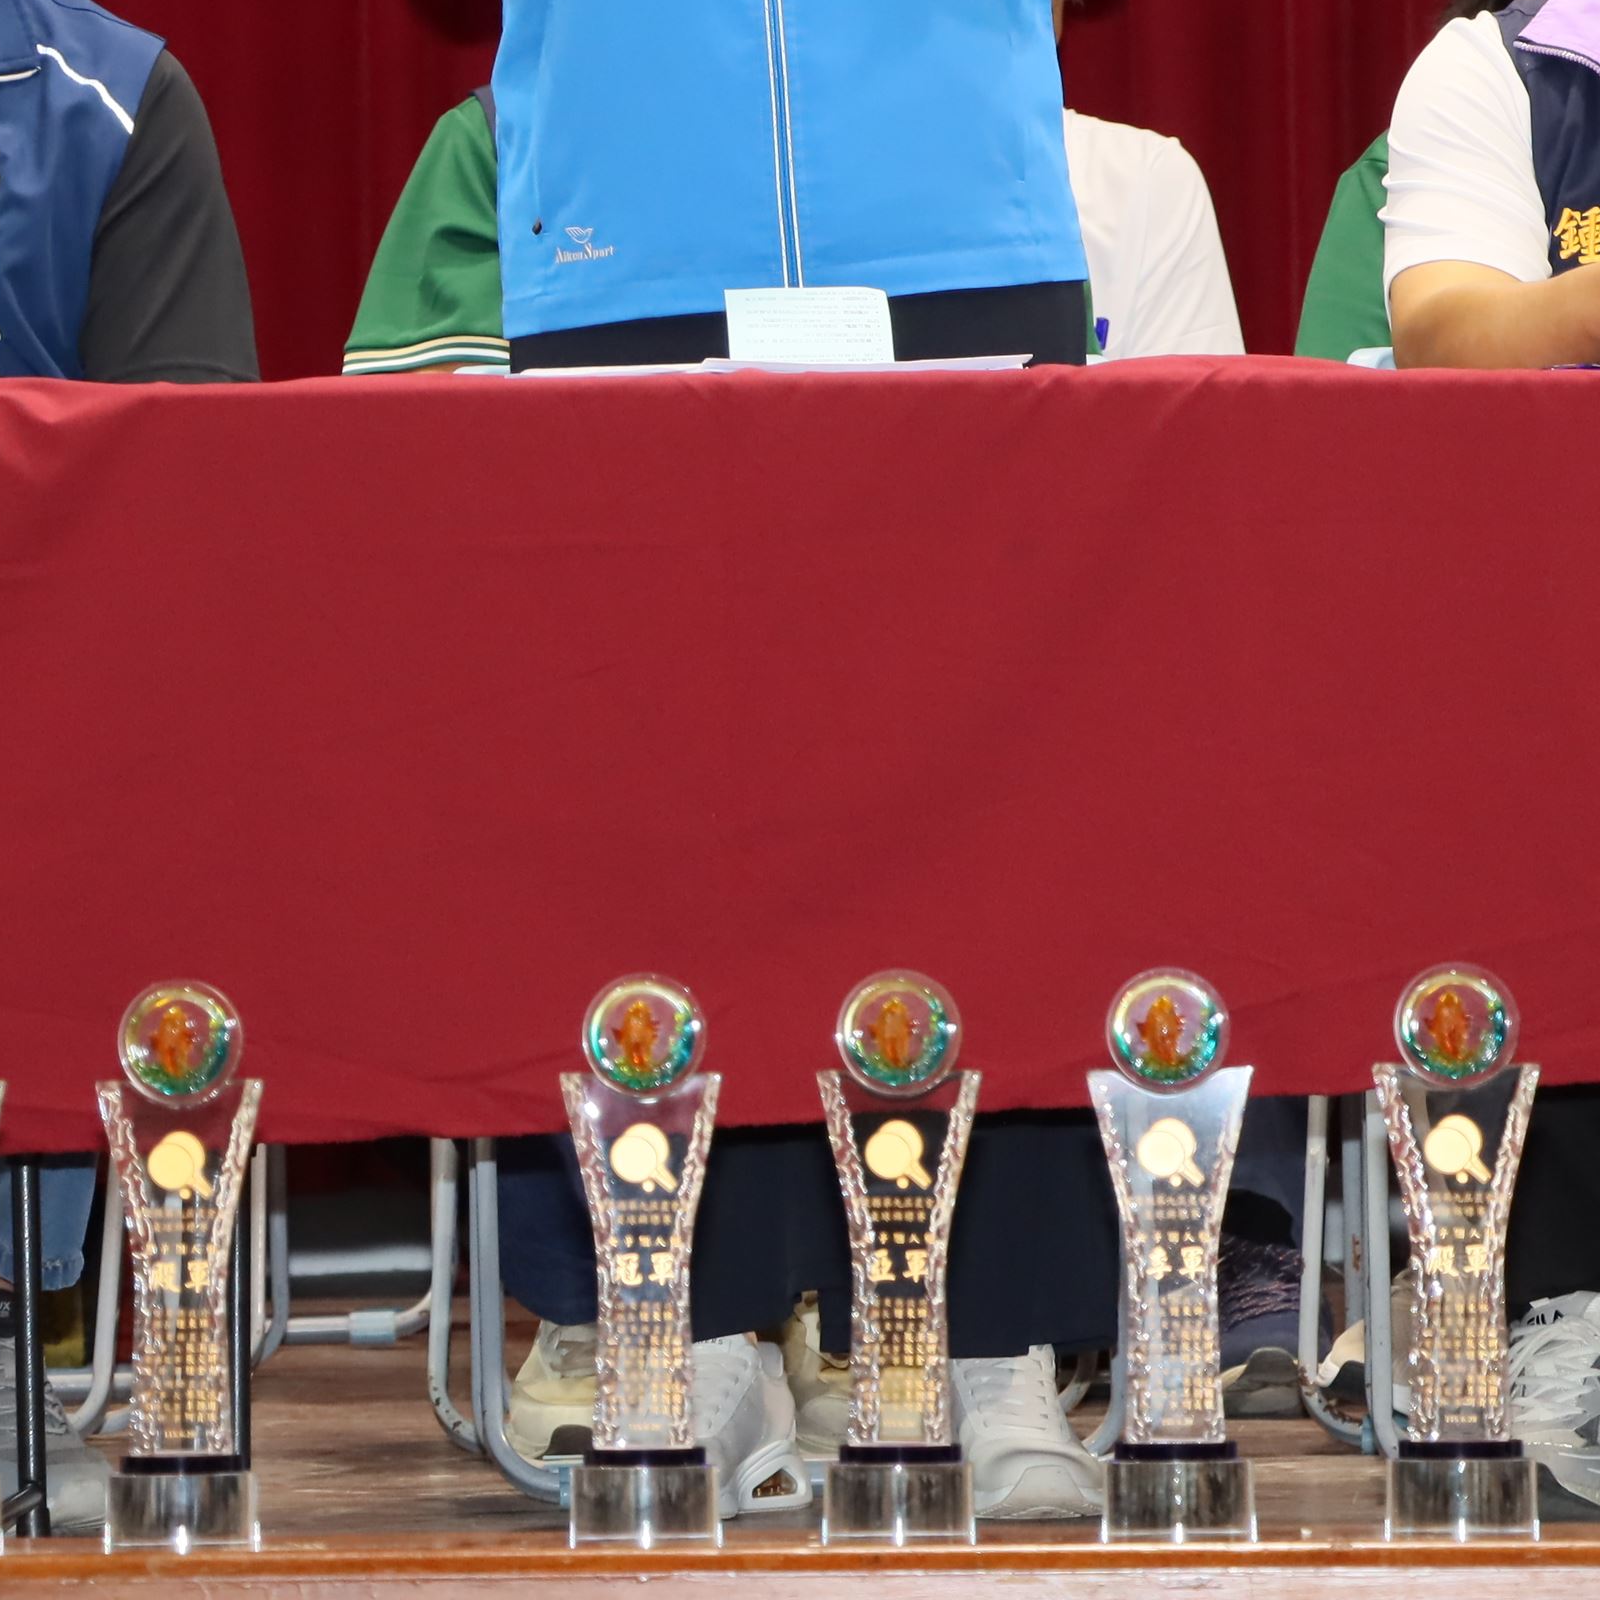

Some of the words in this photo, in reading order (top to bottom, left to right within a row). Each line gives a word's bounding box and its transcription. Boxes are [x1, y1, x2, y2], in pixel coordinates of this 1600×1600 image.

[616, 1252, 675, 1286] 冠軍
[868, 1248, 930, 1282] 亞軍
[1146, 1245, 1206, 1281] 季軍
